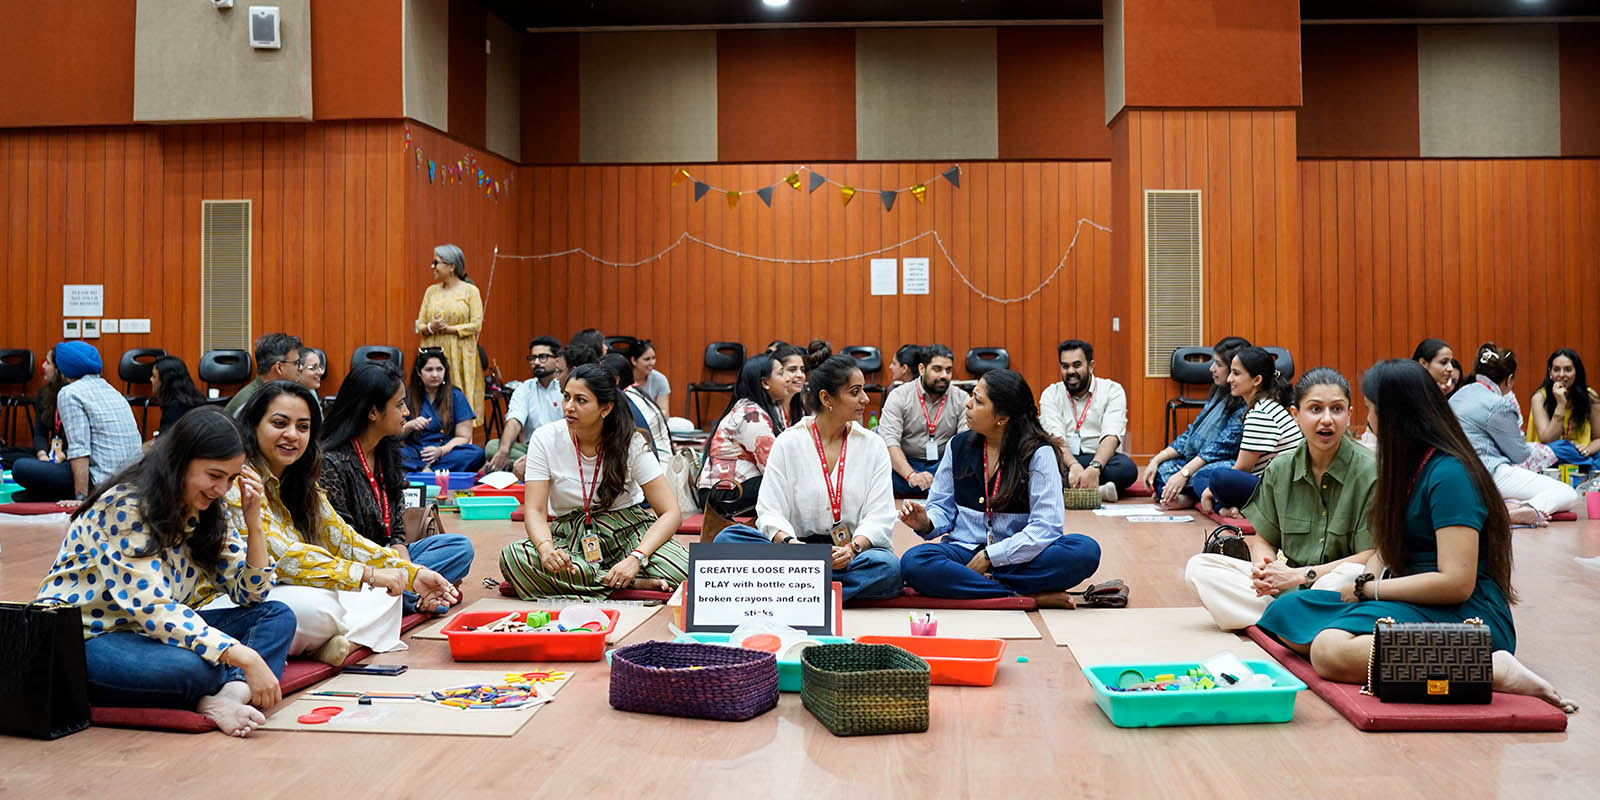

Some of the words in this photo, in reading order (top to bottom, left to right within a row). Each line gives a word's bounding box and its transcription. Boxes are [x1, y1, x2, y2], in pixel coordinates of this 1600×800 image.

[699, 566, 749, 574] CREATIVE
[752, 566, 785, 574] LOOSE
[788, 566, 821, 574] PARTS
[788, 582, 815, 590] caps,
[734, 596, 774, 604] crayons
[744, 609, 774, 617] stiks
